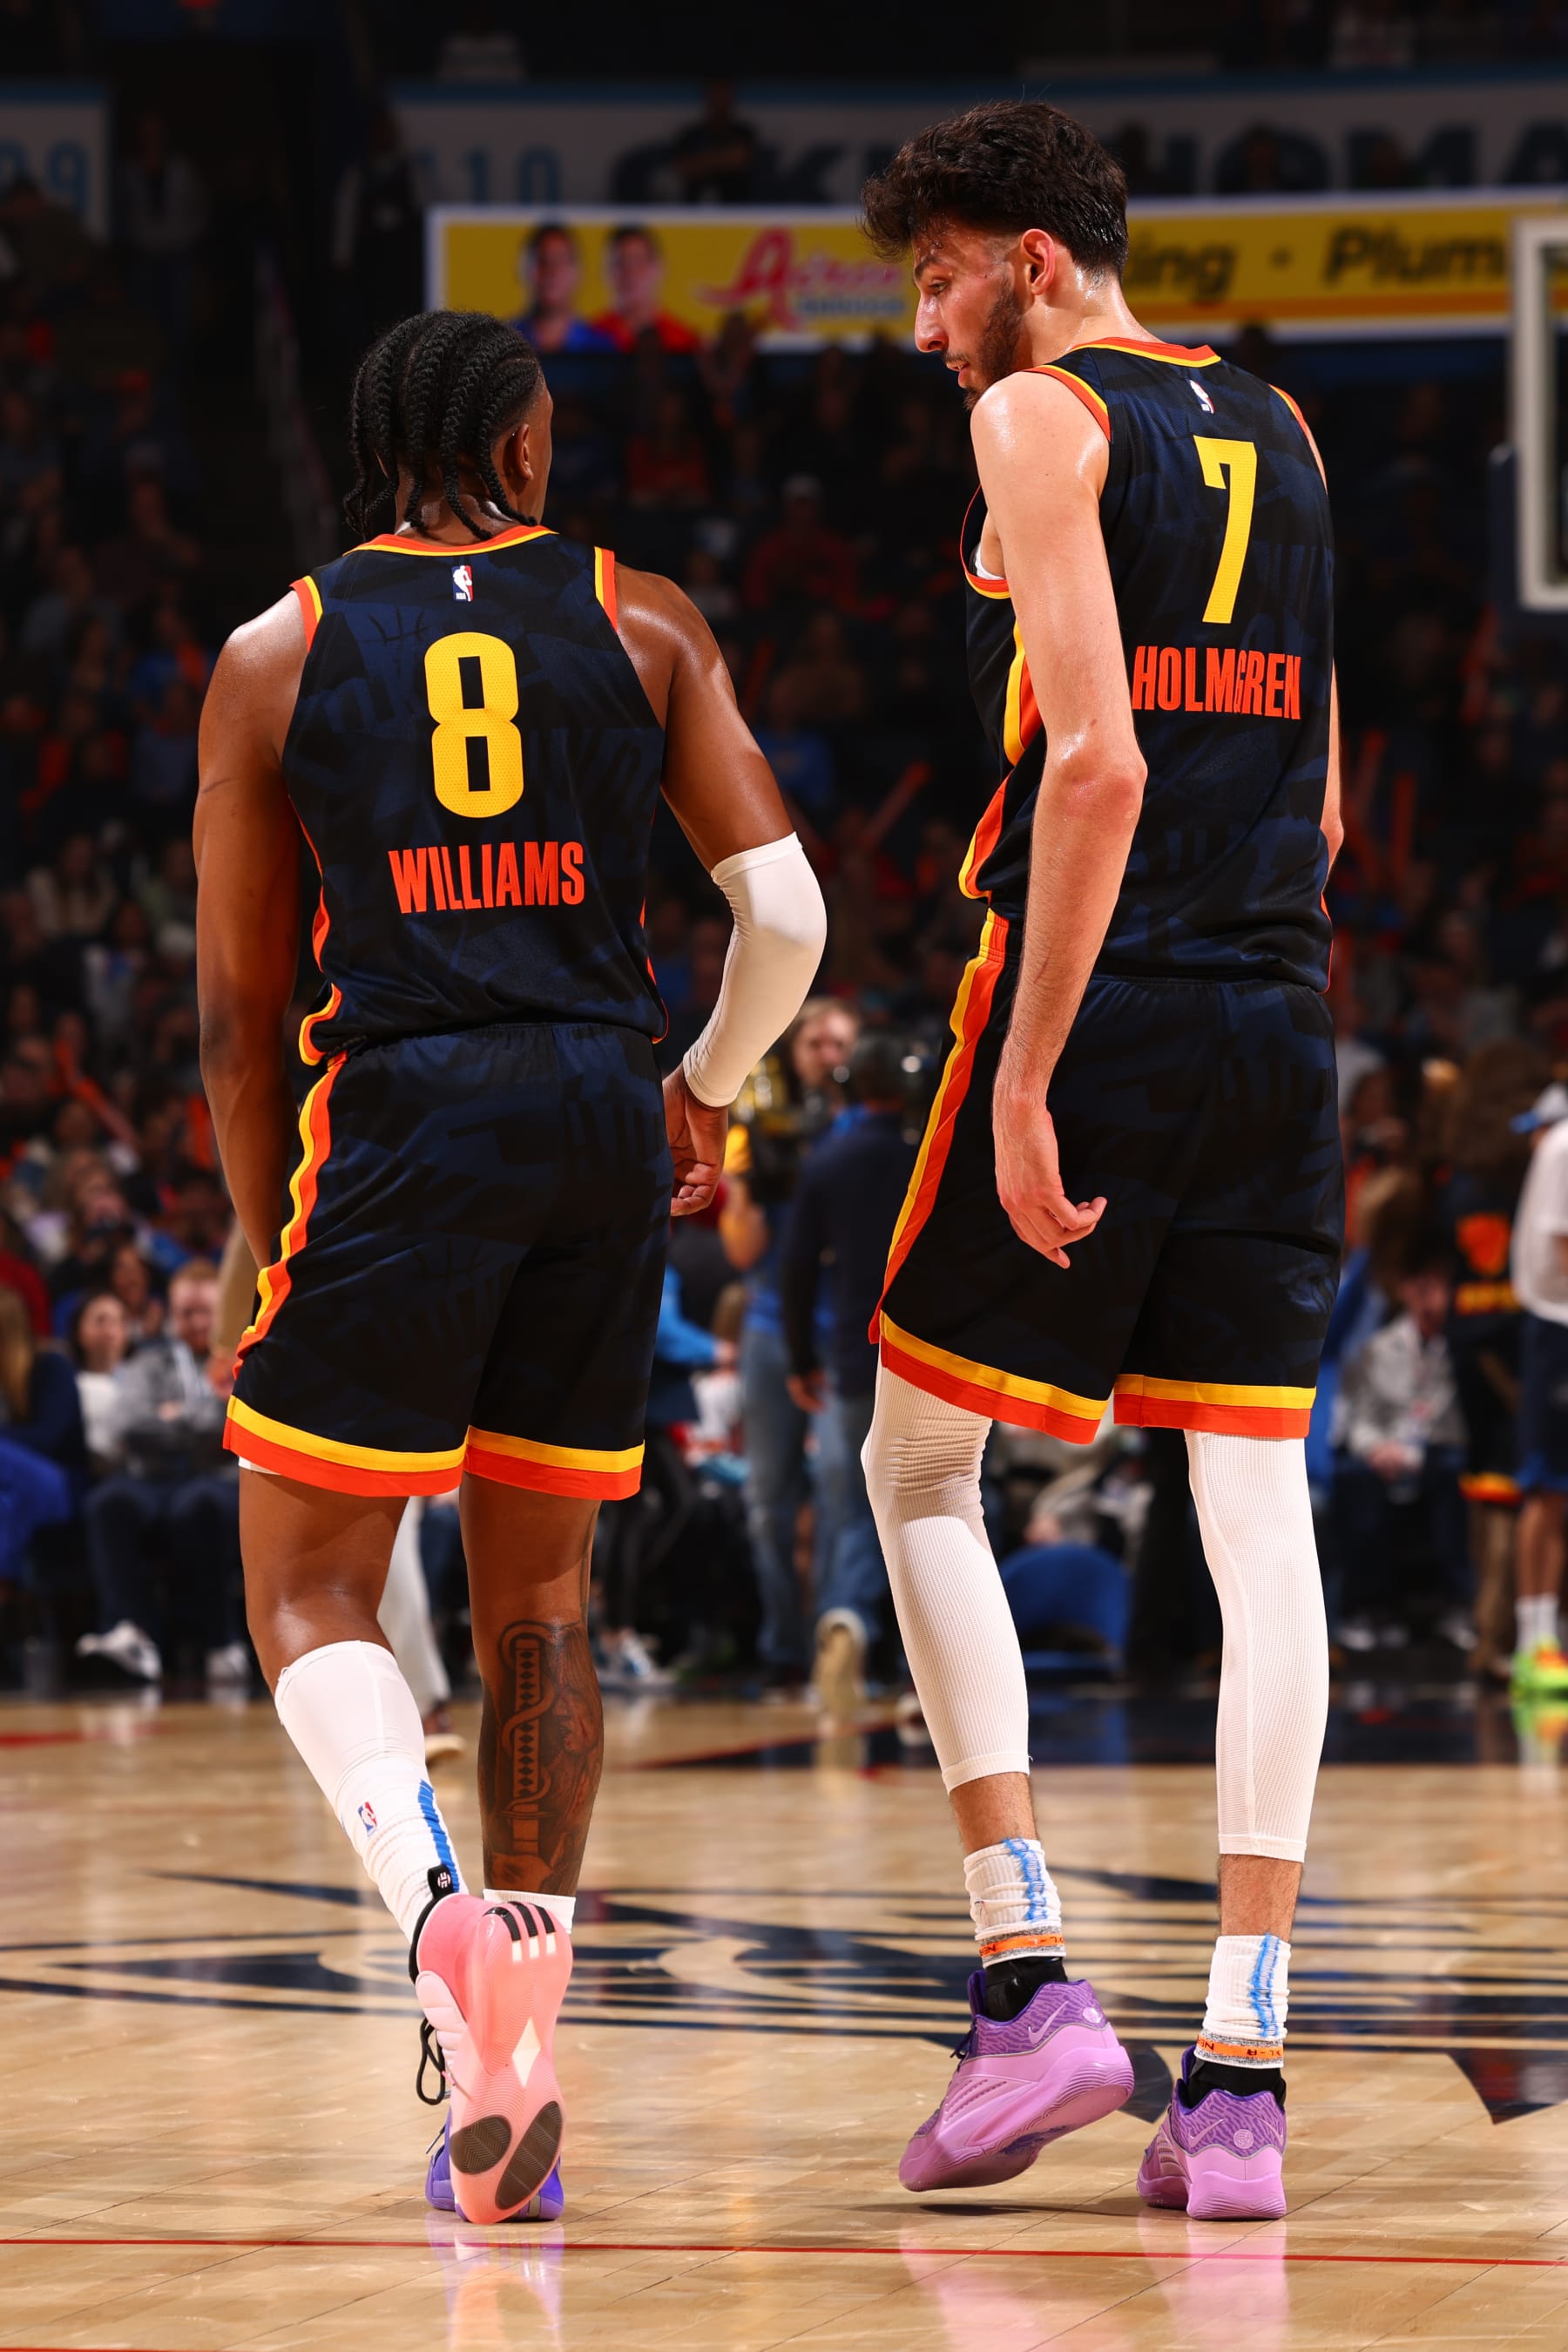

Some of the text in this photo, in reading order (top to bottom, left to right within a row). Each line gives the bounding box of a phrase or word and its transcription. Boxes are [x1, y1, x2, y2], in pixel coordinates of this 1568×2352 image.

[1321, 225, 1507, 289] Plum
[1193, 436, 1258, 625] 7
[1132, 645, 1302, 721] HOLMGREN
[424, 631, 524, 819] 8
[388, 840, 586, 915] WILLIAMS
